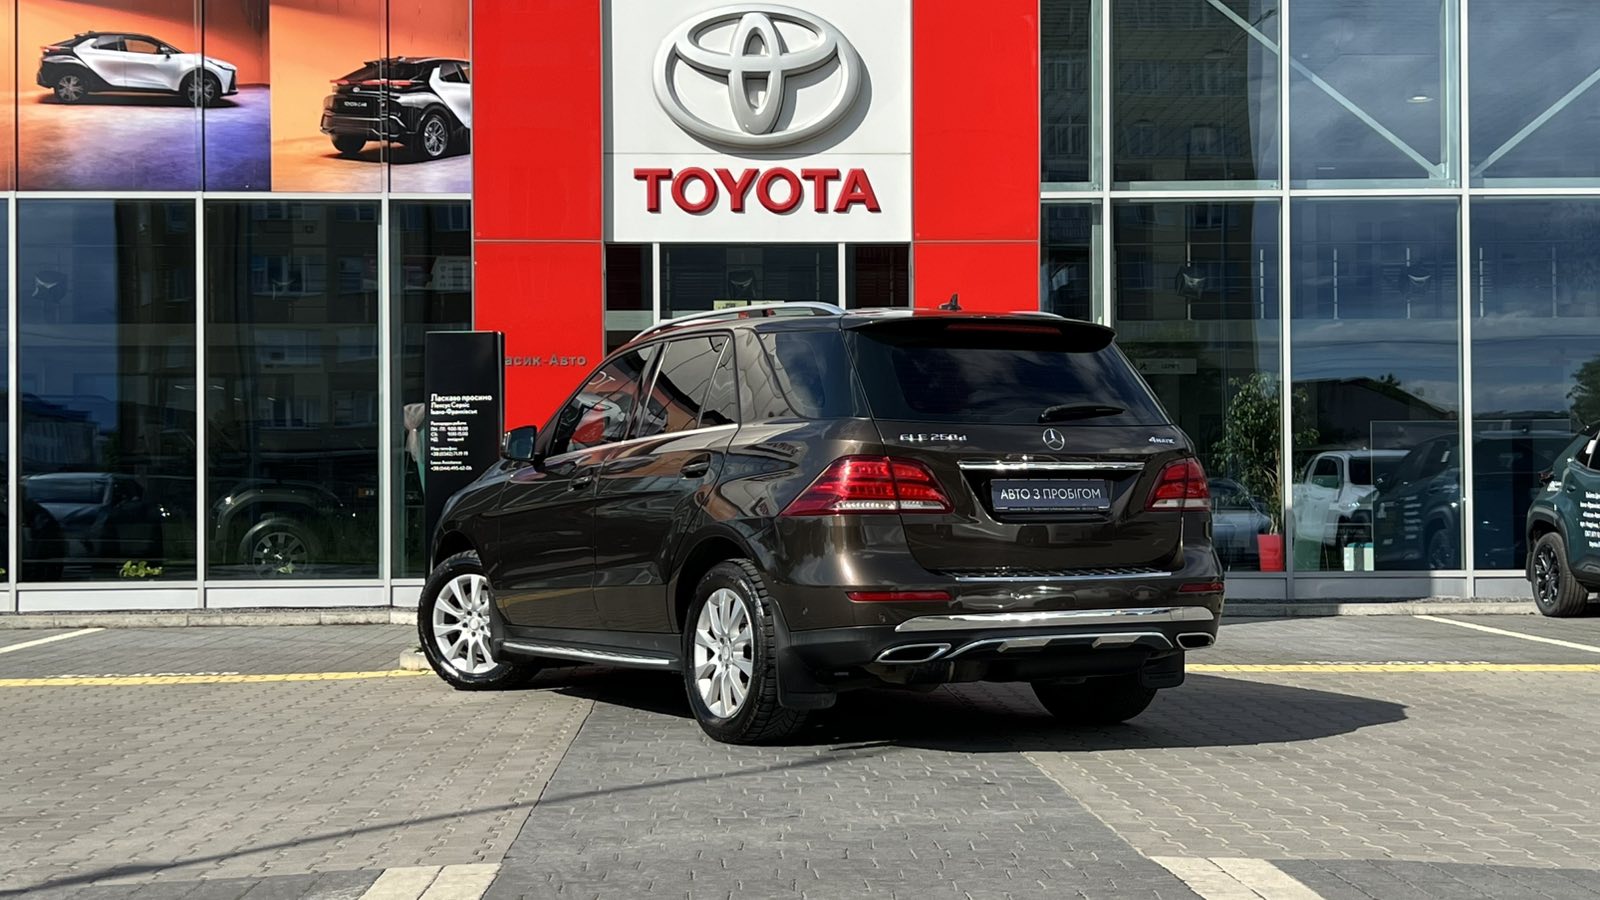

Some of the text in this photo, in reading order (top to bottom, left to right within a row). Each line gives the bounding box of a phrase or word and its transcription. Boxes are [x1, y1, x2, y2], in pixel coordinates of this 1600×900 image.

[634, 167, 881, 214] TOYOTA
[549, 354, 587, 366] Авто
[430, 393, 493, 403] Ласкаво просимо
[899, 433, 929, 442] GLE
[1000, 488, 1101, 500] АВТО З ПРОБІГОМ
